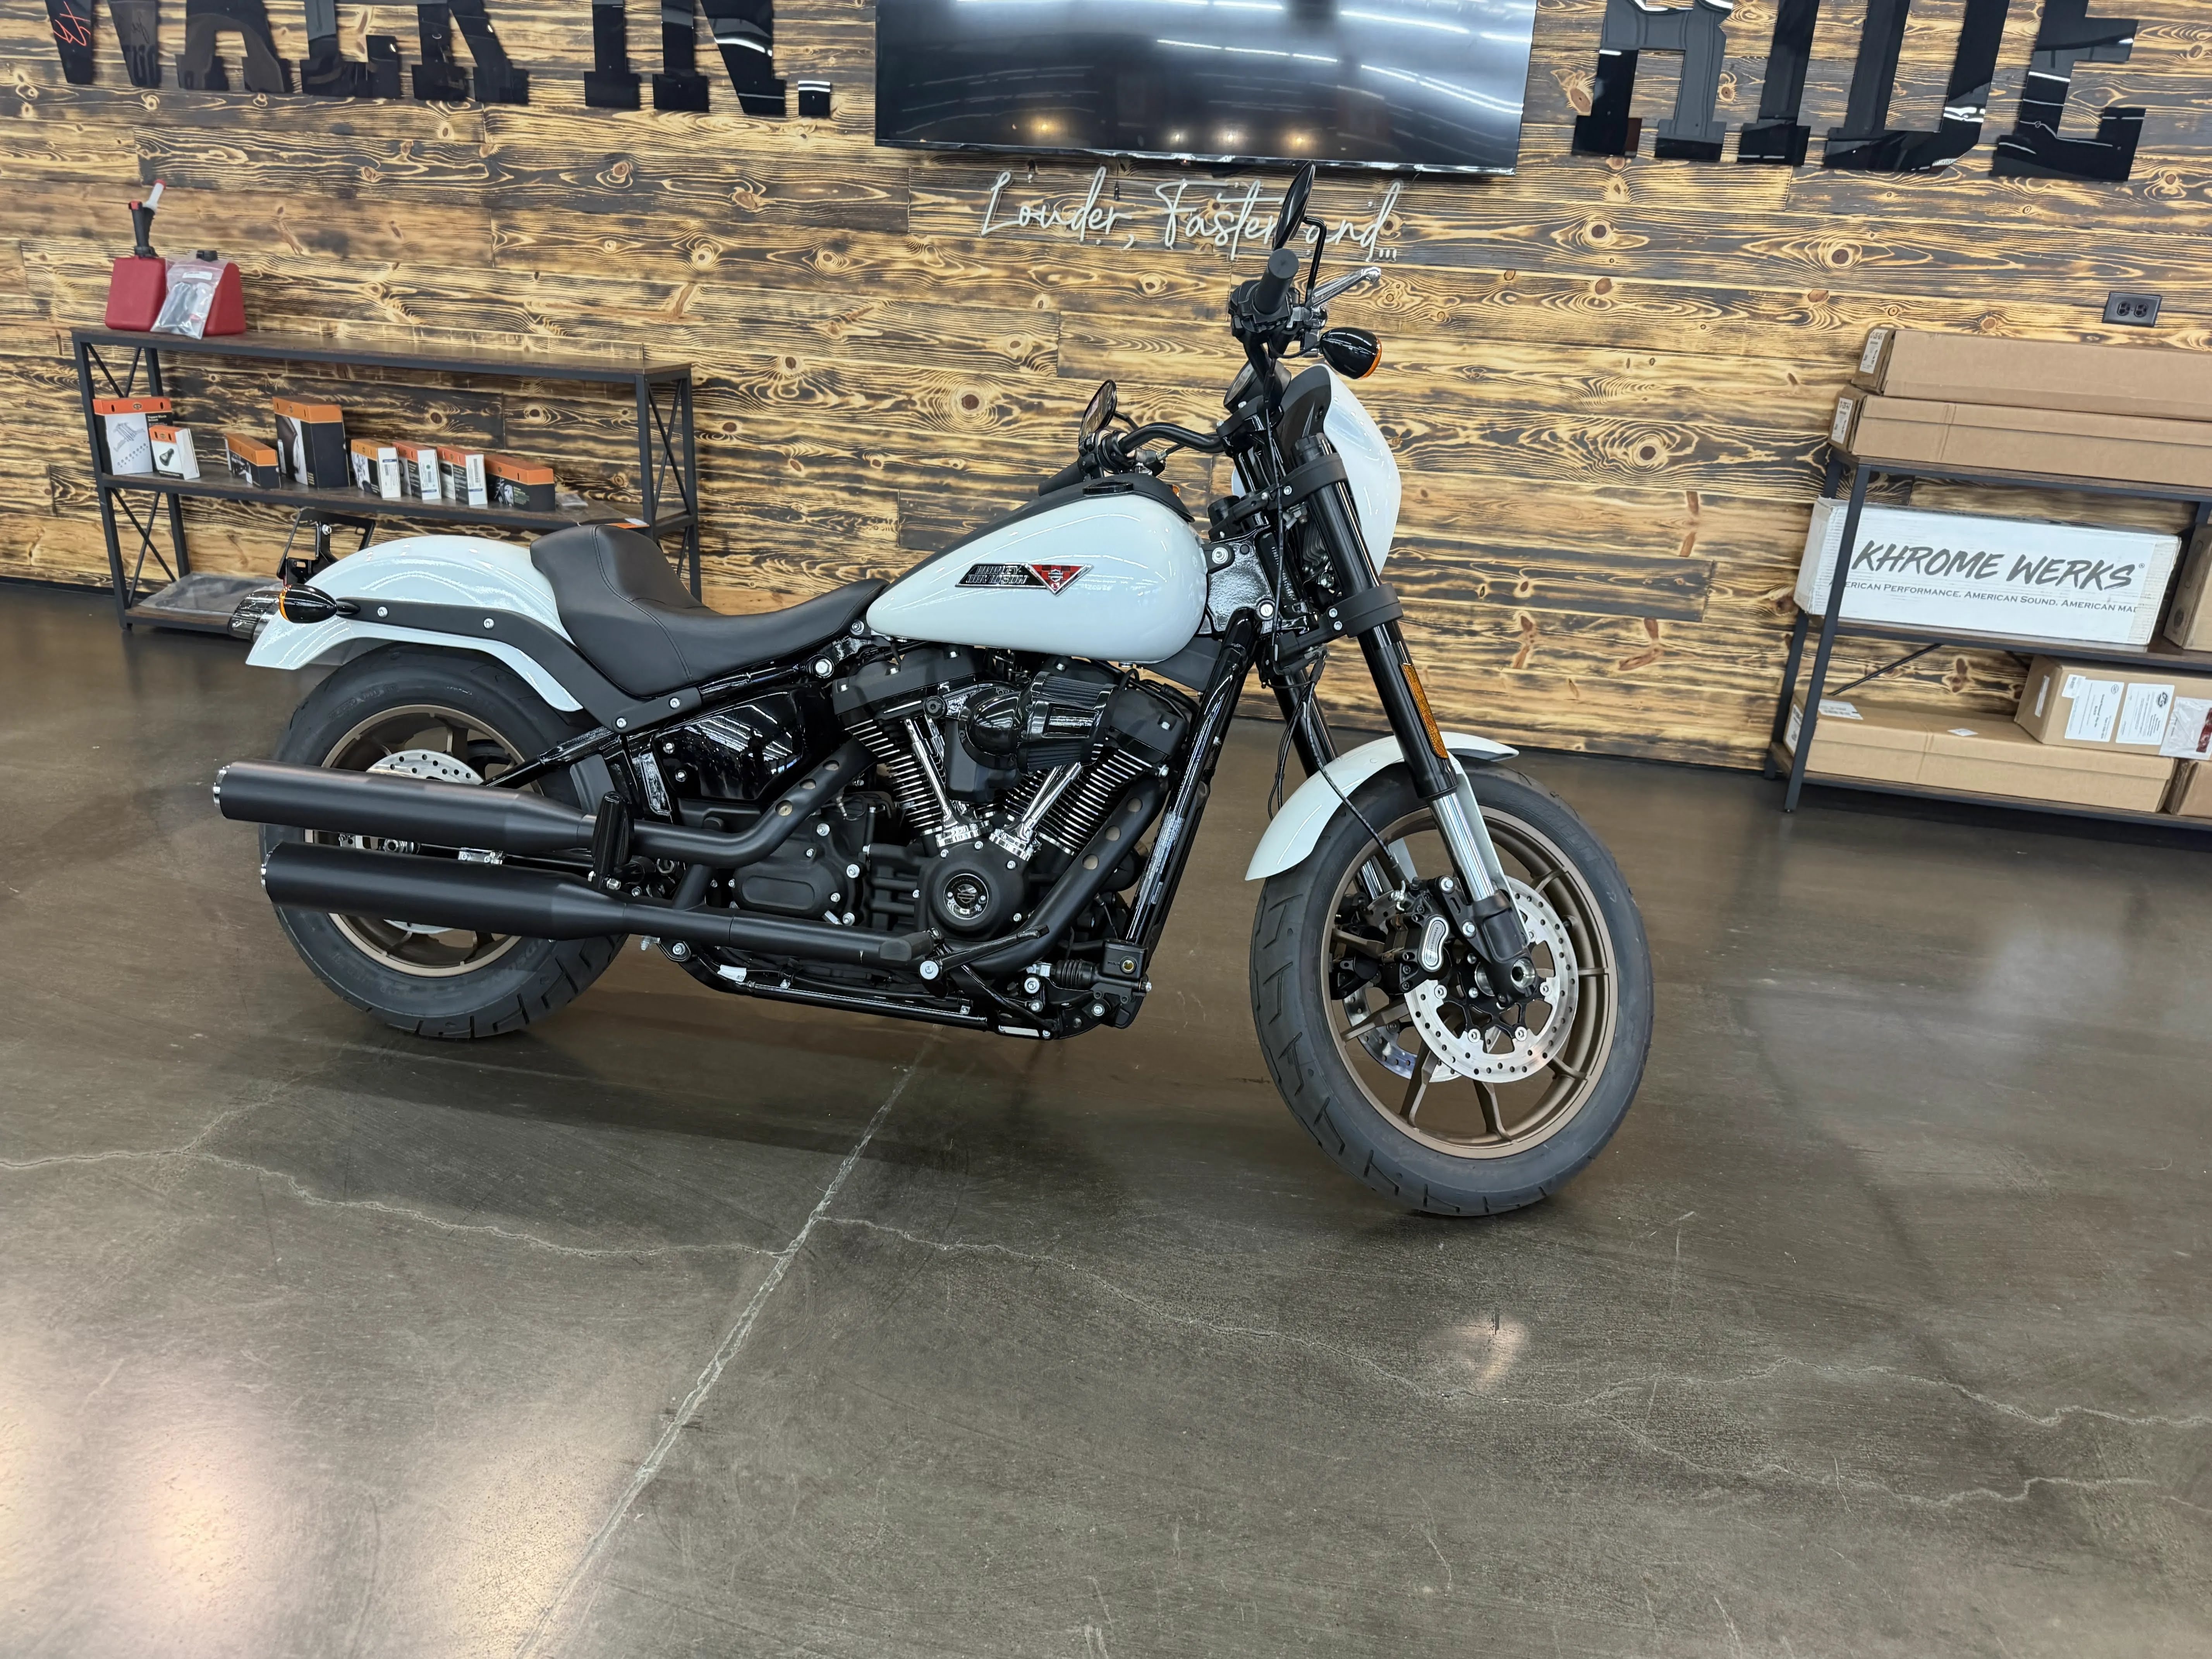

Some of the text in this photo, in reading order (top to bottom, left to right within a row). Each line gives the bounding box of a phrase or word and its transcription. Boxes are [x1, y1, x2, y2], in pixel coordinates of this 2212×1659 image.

[980, 166, 1135, 250] Louder,
[1851, 540, 2005, 580] KHROME
[1829, 579, 1881, 591] ERICAN
[1883, 584, 1961, 598] PERFORMANCE.
[1964, 591, 2018, 603] AMERICAN
[2020, 596, 2058, 606] SOUND.
[2061, 599, 2116, 611] AMERICAN
